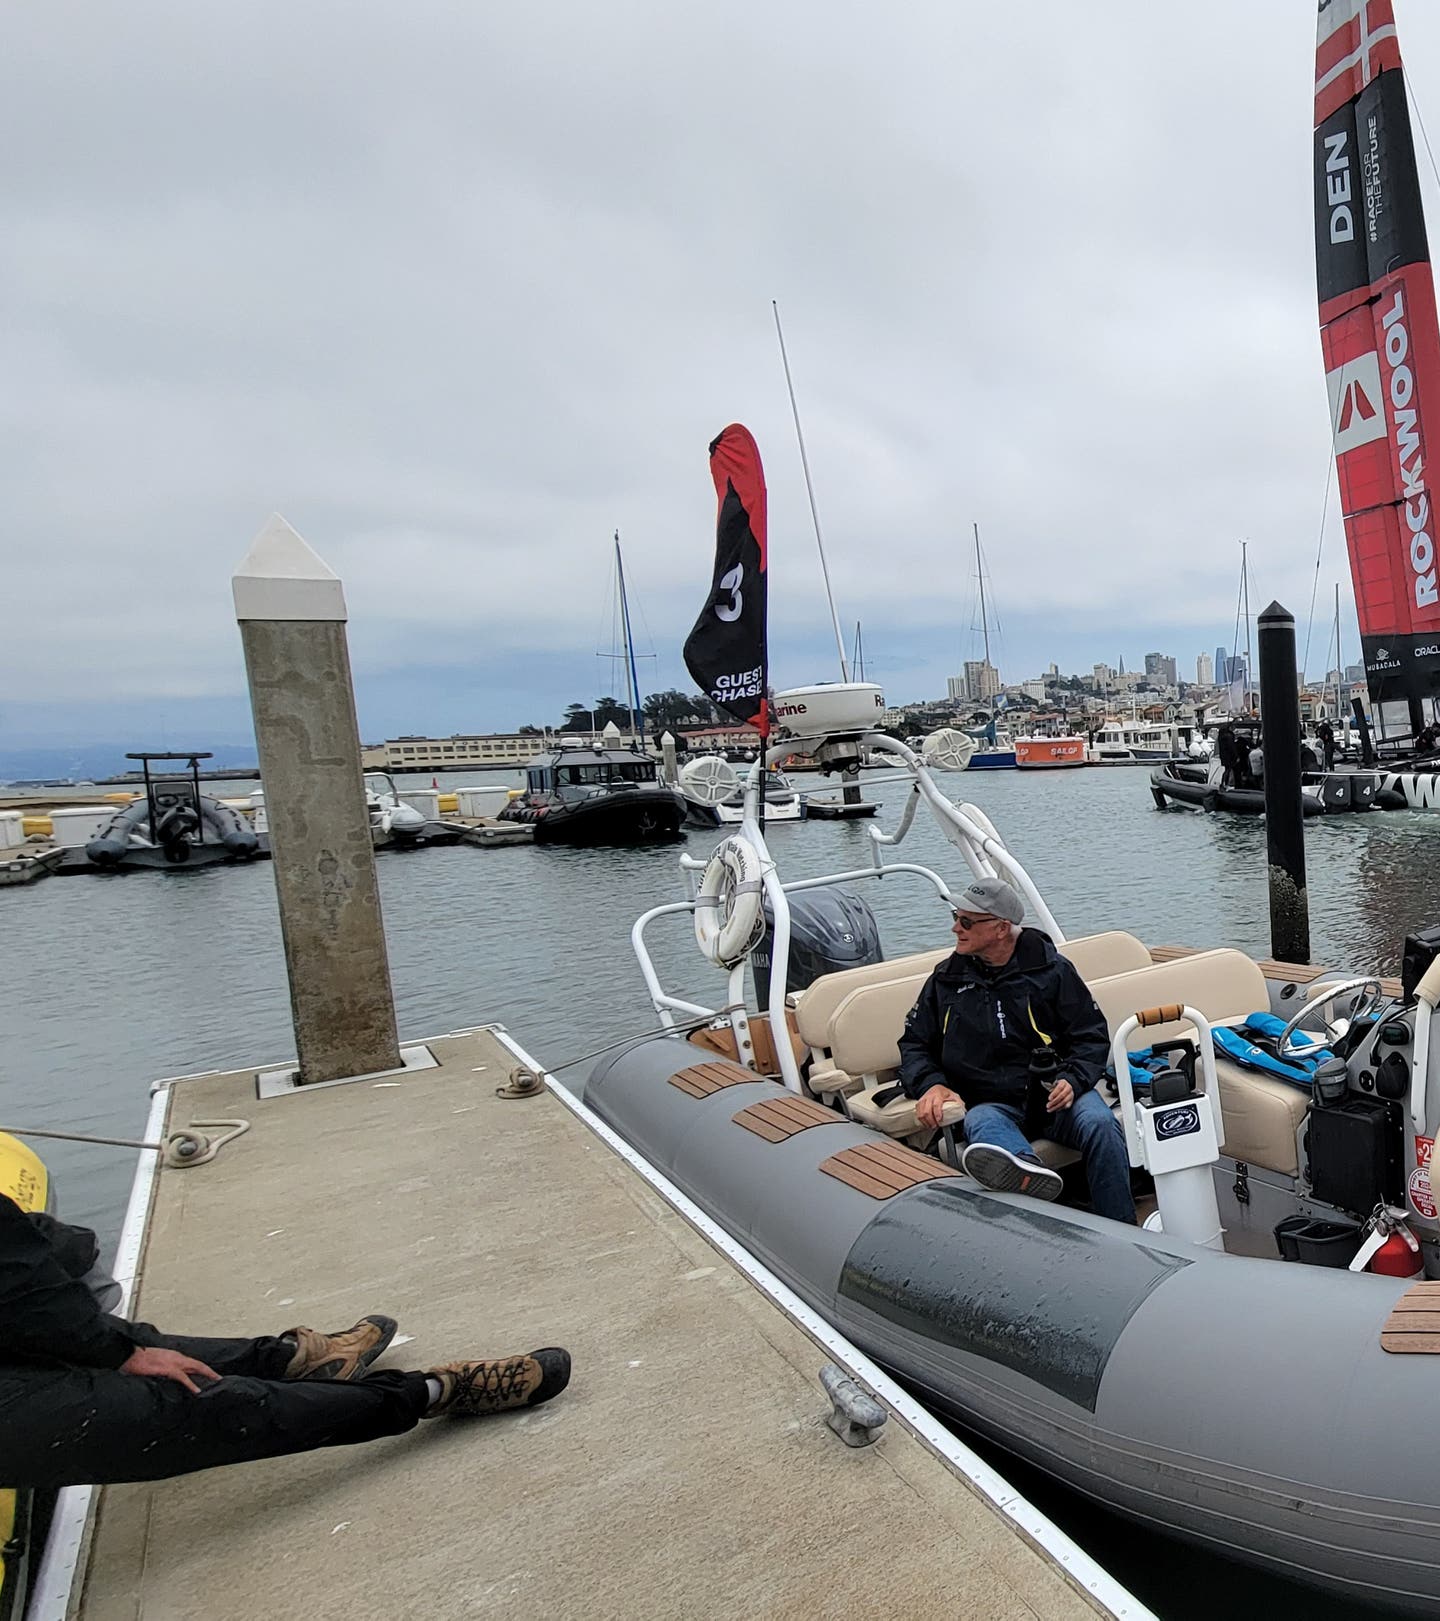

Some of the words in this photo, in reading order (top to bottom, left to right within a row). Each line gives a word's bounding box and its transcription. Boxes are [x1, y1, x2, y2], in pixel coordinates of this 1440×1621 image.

[1324, 131, 1354, 245] DEN
[1382, 290, 1439, 609] ROCKWOOL
[714, 562, 744, 622] 3
[715, 665, 762, 688] GUEST
[711, 679, 763, 702] CHASE
[776, 703, 807, 717] arine
[1336, 788, 1344, 798] 4
[1363, 786, 1371, 796] 4
